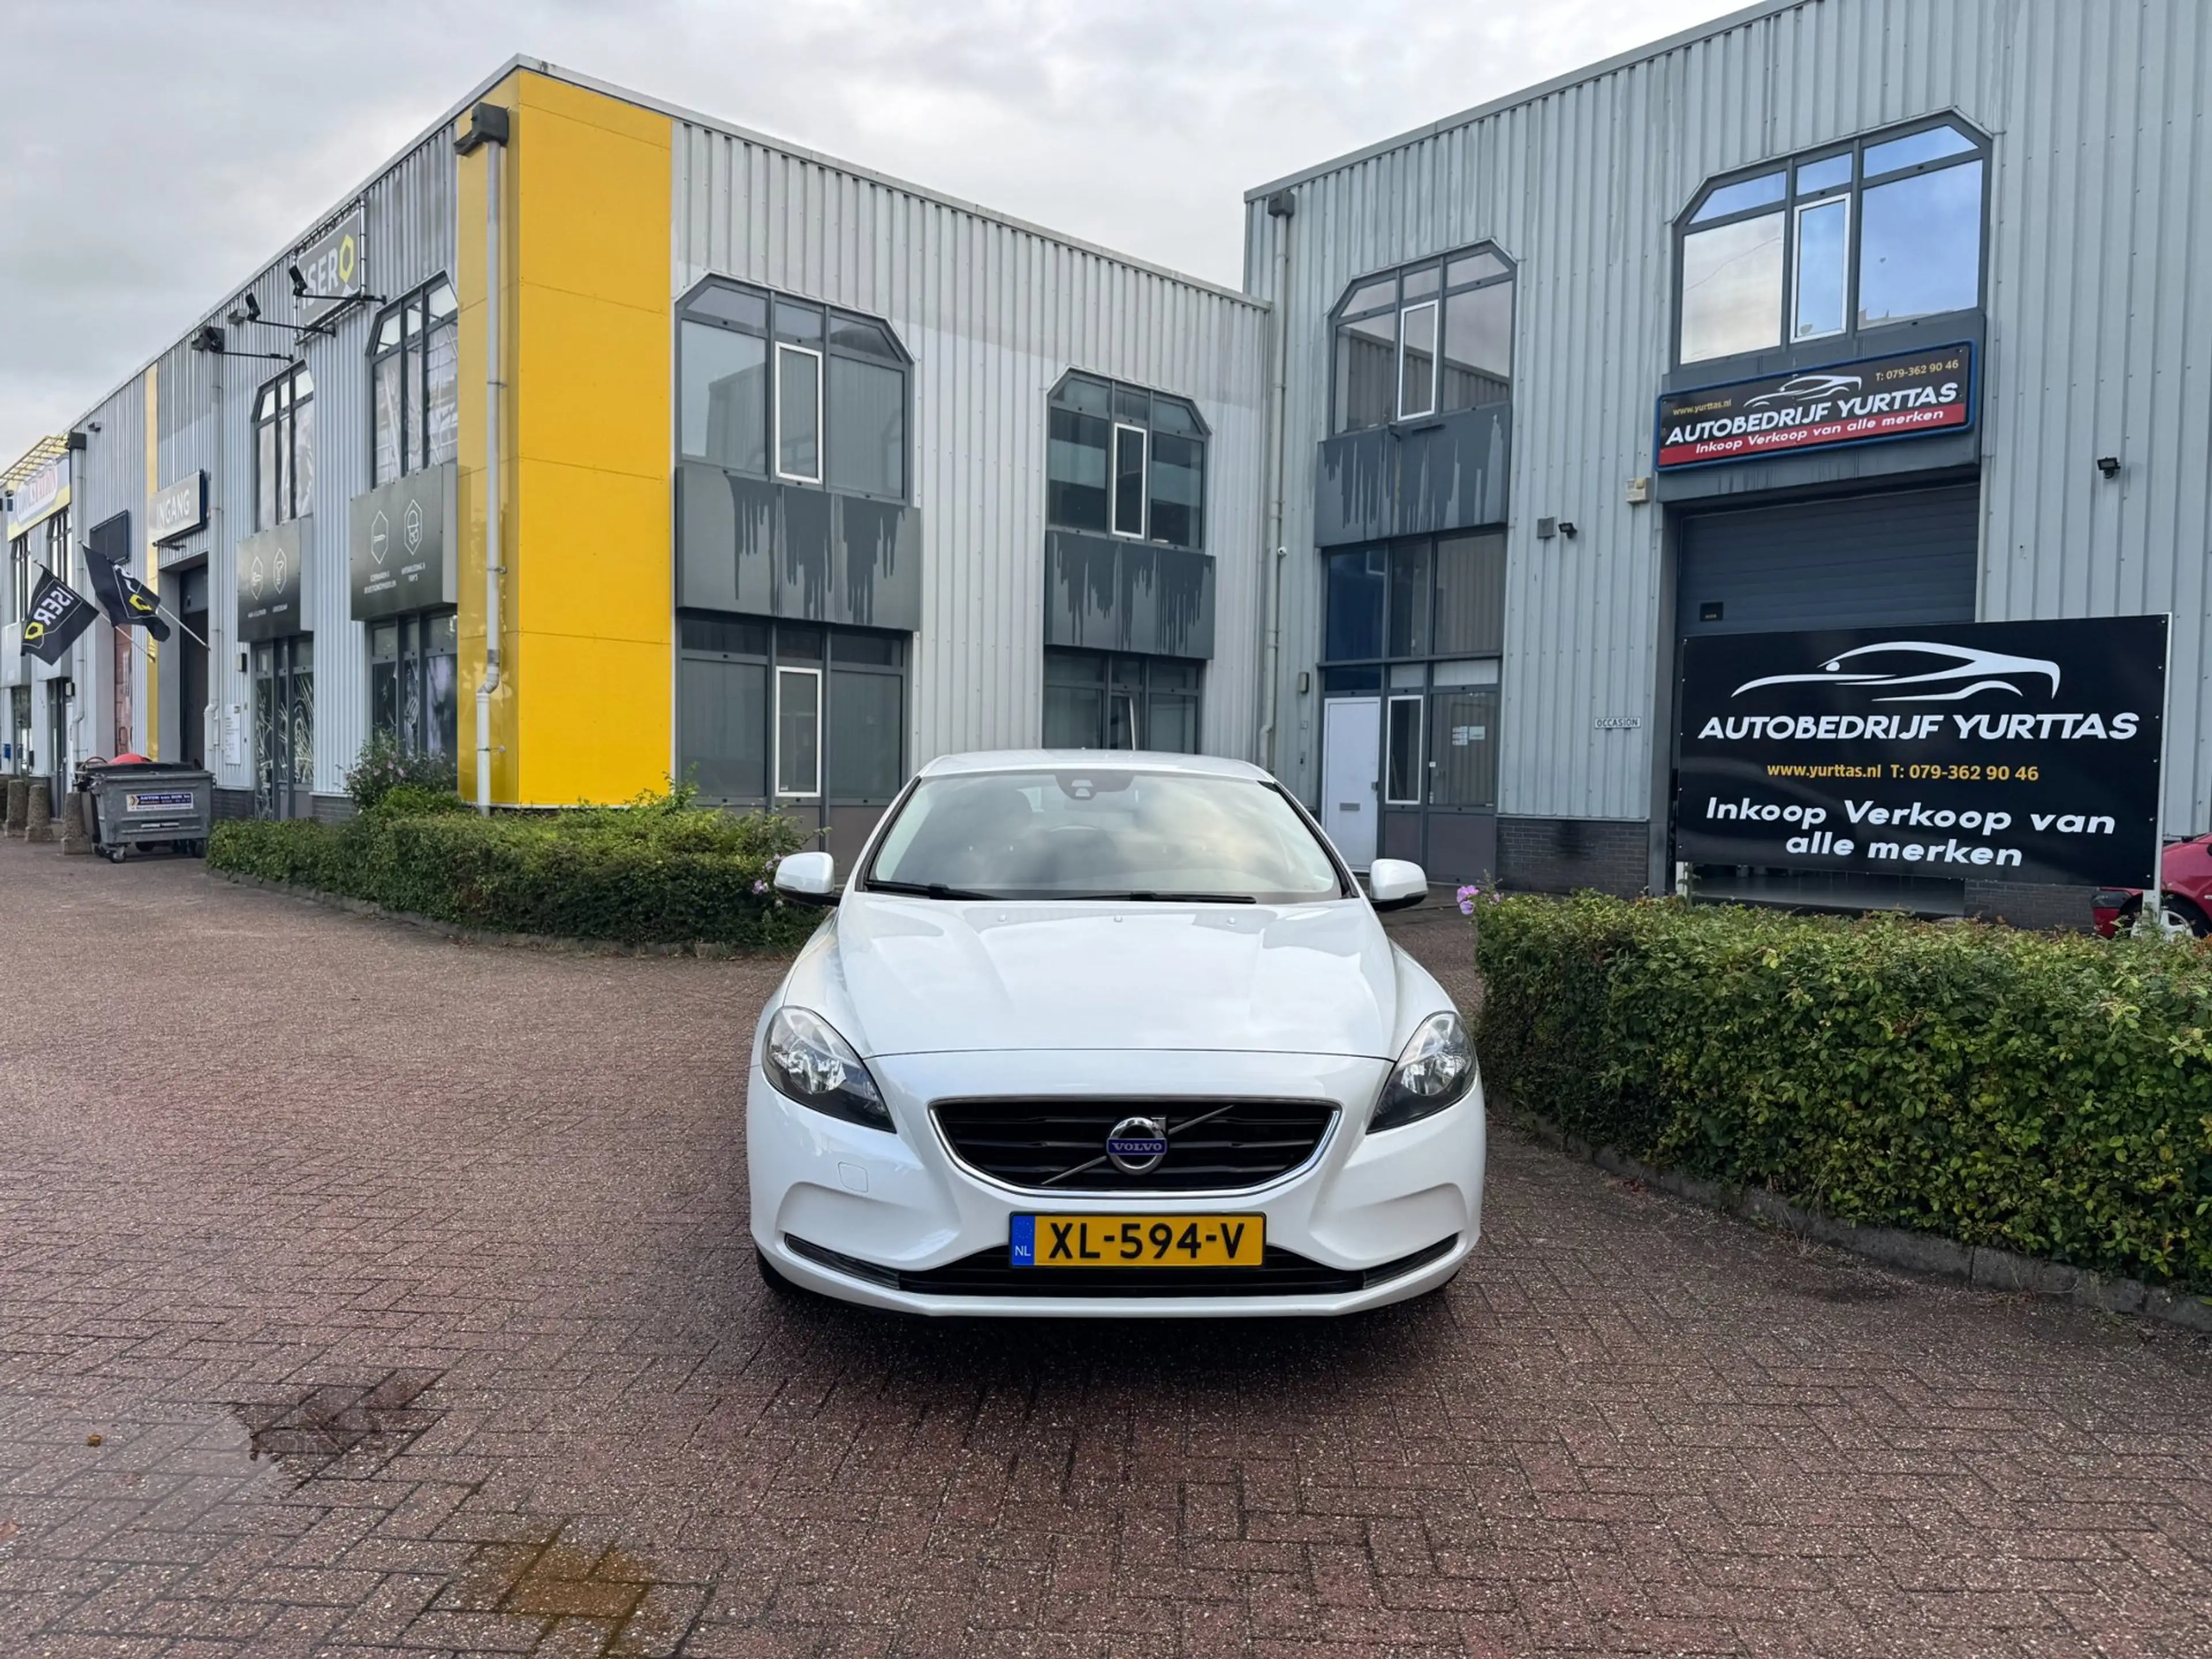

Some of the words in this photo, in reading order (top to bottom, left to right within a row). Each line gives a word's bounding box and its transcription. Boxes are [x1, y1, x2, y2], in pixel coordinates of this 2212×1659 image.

[1876, 372, 1884, 381] T:
[1886, 365, 1927, 380] 079-362
[1929, 362, 1942, 372] 90
[1945, 359, 1959, 370] 46
[1665, 402, 1832, 445] AUTOBEDRIJF
[1837, 382, 1959, 418] YURTTAS
[1673, 399, 1732, 416] www.yurttas.nl
[1695, 439, 1743, 454] Inkoop
[1748, 430, 1808, 446] Verkoop
[1813, 425, 1842, 436] van
[1847, 419, 1876, 431] alle
[1881, 410, 1944, 427] merken
[1597, 718, 1638, 726] OCCASION
[1697, 715, 1945, 740] AUTOBEDRIJF
[1952, 712, 2140, 740] YURTTAS
[1767, 764, 1881, 779] www.yurttas.nl
[1890, 764, 1904, 779] T:
[1908, 764, 1981, 780] 079-362
[1986, 766, 2010, 781] 90
[2014, 766, 2040, 781] 46
[1706, 797, 1827, 830] Inkoop
[1844, 800, 2012, 836] Verkoop
[2029, 813, 2116, 835] van
[1785, 831, 1855, 856] alle
[1867, 838, 2023, 866] merken
[1112, 1143, 1162, 1151] VOLVO
[1014, 1245, 1031, 1256] NL
[1048, 1222, 1245, 1260] XL-594-V
